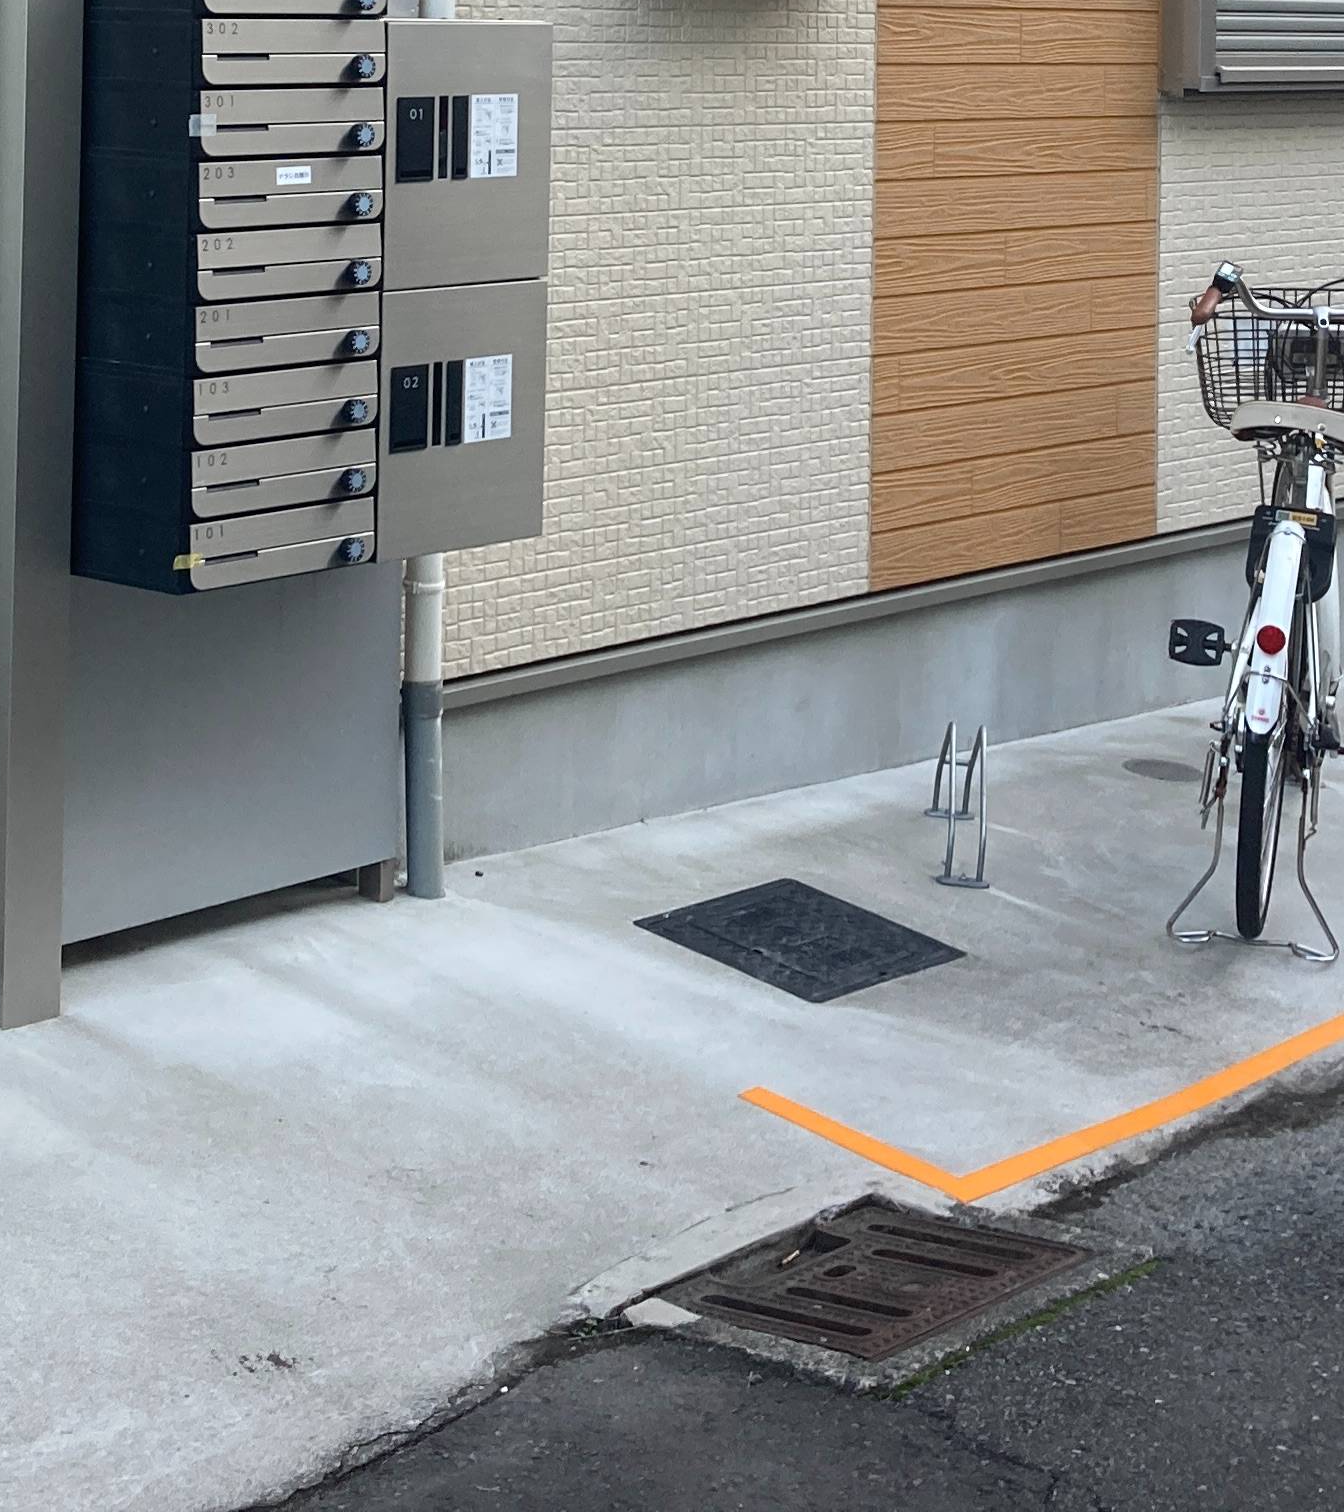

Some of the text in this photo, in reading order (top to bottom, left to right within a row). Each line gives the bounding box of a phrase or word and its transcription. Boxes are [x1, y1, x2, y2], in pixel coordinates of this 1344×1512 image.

[206, 22, 239, 36] 302
[204, 95, 235, 109] 301
[409, 108, 424, 121] 01
[203, 167, 235, 180] 203
[201, 238, 235, 252] 202
[199, 309, 231, 324] 201
[197, 381, 231, 396] 103
[402, 376, 420, 389] 02
[196, 453, 229, 468] 102
[194, 525, 225, 540] 101
